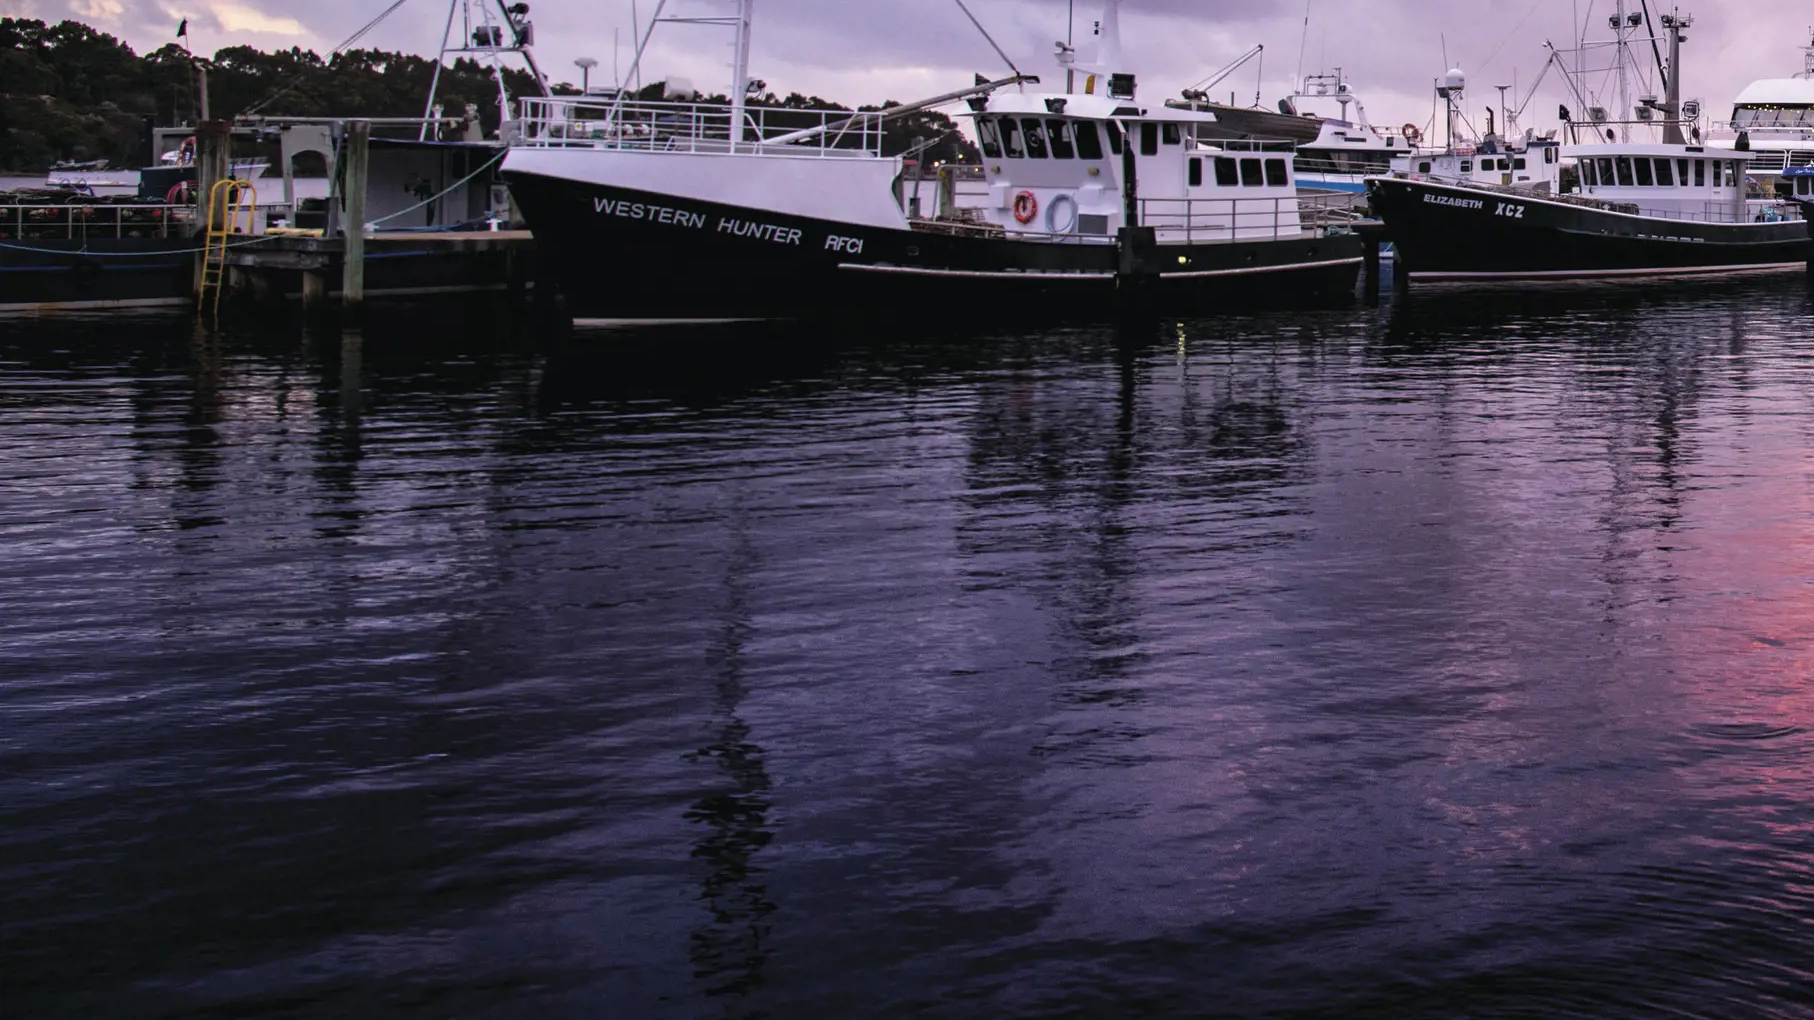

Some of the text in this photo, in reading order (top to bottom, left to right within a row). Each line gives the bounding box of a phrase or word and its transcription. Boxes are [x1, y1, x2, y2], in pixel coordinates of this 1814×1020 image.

[593, 196, 864, 254] WESTERN HUNTER RFCI
[1423, 193, 1525, 219] ELIZABETH XCZ
